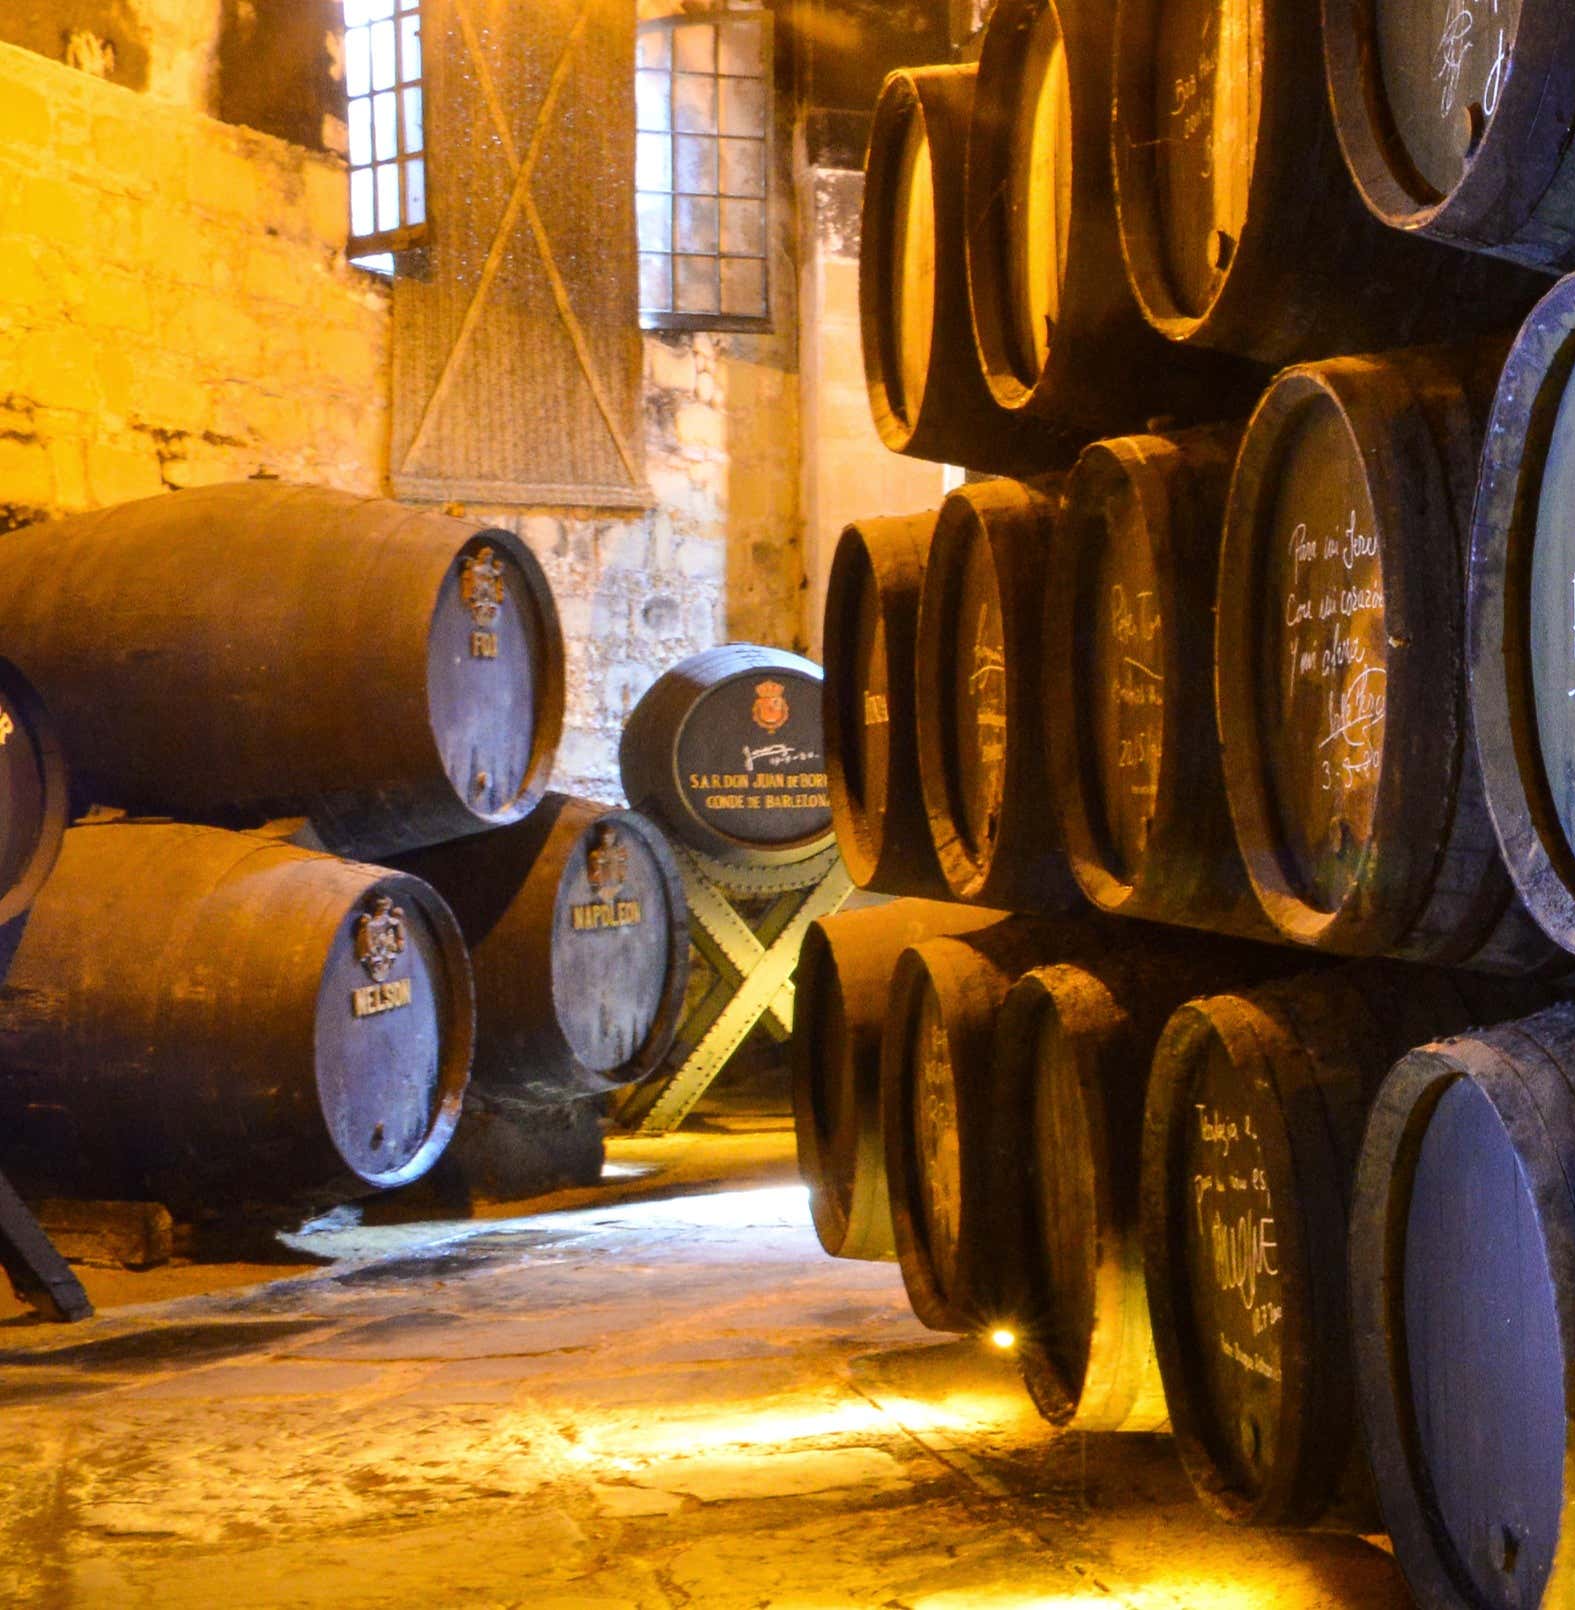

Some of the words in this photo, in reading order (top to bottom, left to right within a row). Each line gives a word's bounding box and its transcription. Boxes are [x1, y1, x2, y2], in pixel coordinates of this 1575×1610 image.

[723, 774, 749, 788] DON
[752, 773, 784, 789] JUAN
[705, 795, 744, 809] CONDE
[747, 795, 761, 809] DE
[765, 793, 831, 809] BARCELON
[352, 978, 411, 1017] NELSON
